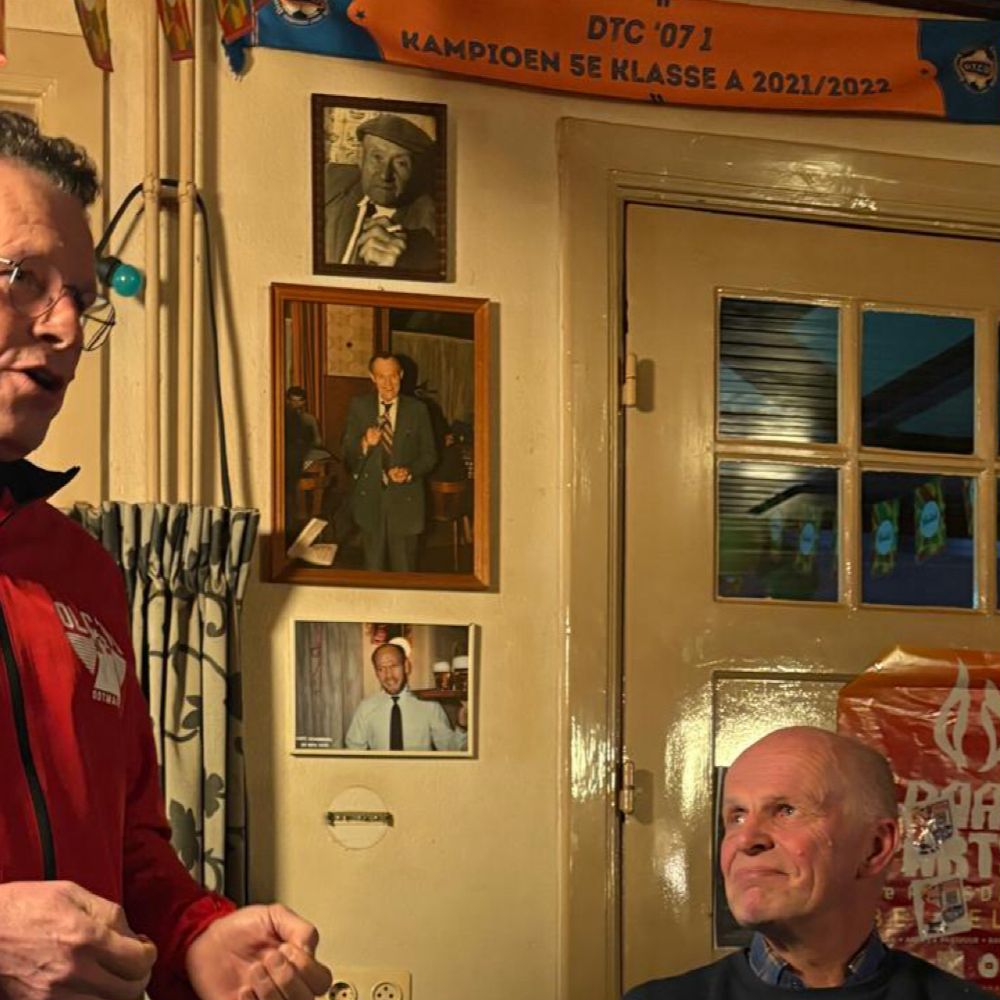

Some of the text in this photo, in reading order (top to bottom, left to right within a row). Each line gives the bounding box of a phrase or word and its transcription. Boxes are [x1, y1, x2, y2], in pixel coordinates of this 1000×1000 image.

[587, 14, 645, 45] DTC
[654, 22, 695, 49] '07
[401, 30, 892, 96] KAMPIOEN 5E KLASSE A 2021/2022
